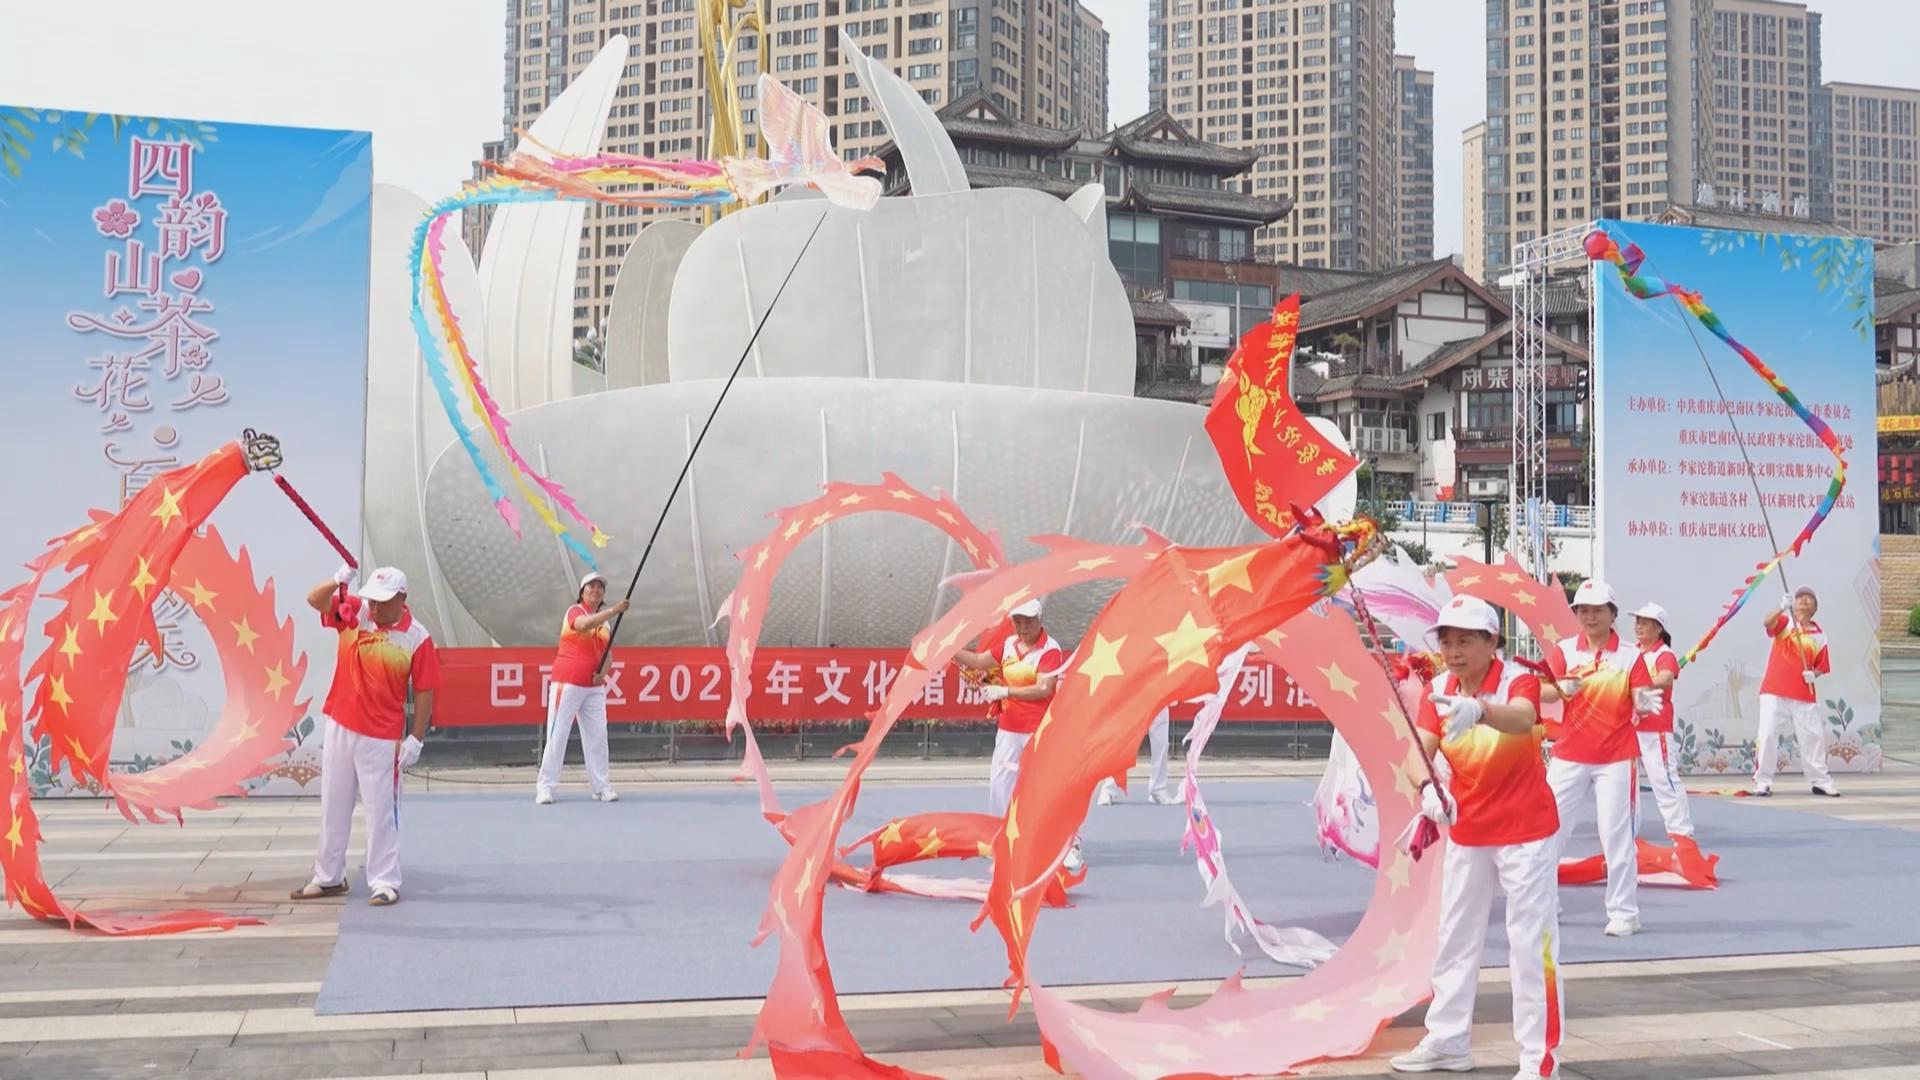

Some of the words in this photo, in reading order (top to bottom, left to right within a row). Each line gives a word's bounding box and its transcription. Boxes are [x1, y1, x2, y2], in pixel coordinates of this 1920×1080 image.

[1628, 395, 1851, 419] 主办单位：中共重庆市巴南区李家沱街作委员会
[1679, 429, 1854, 449] 重庆市巴南区人民政府李家沱街道处
[1680, 490, 1855, 509] 李家沱街道各村、社区新时代文明践站
